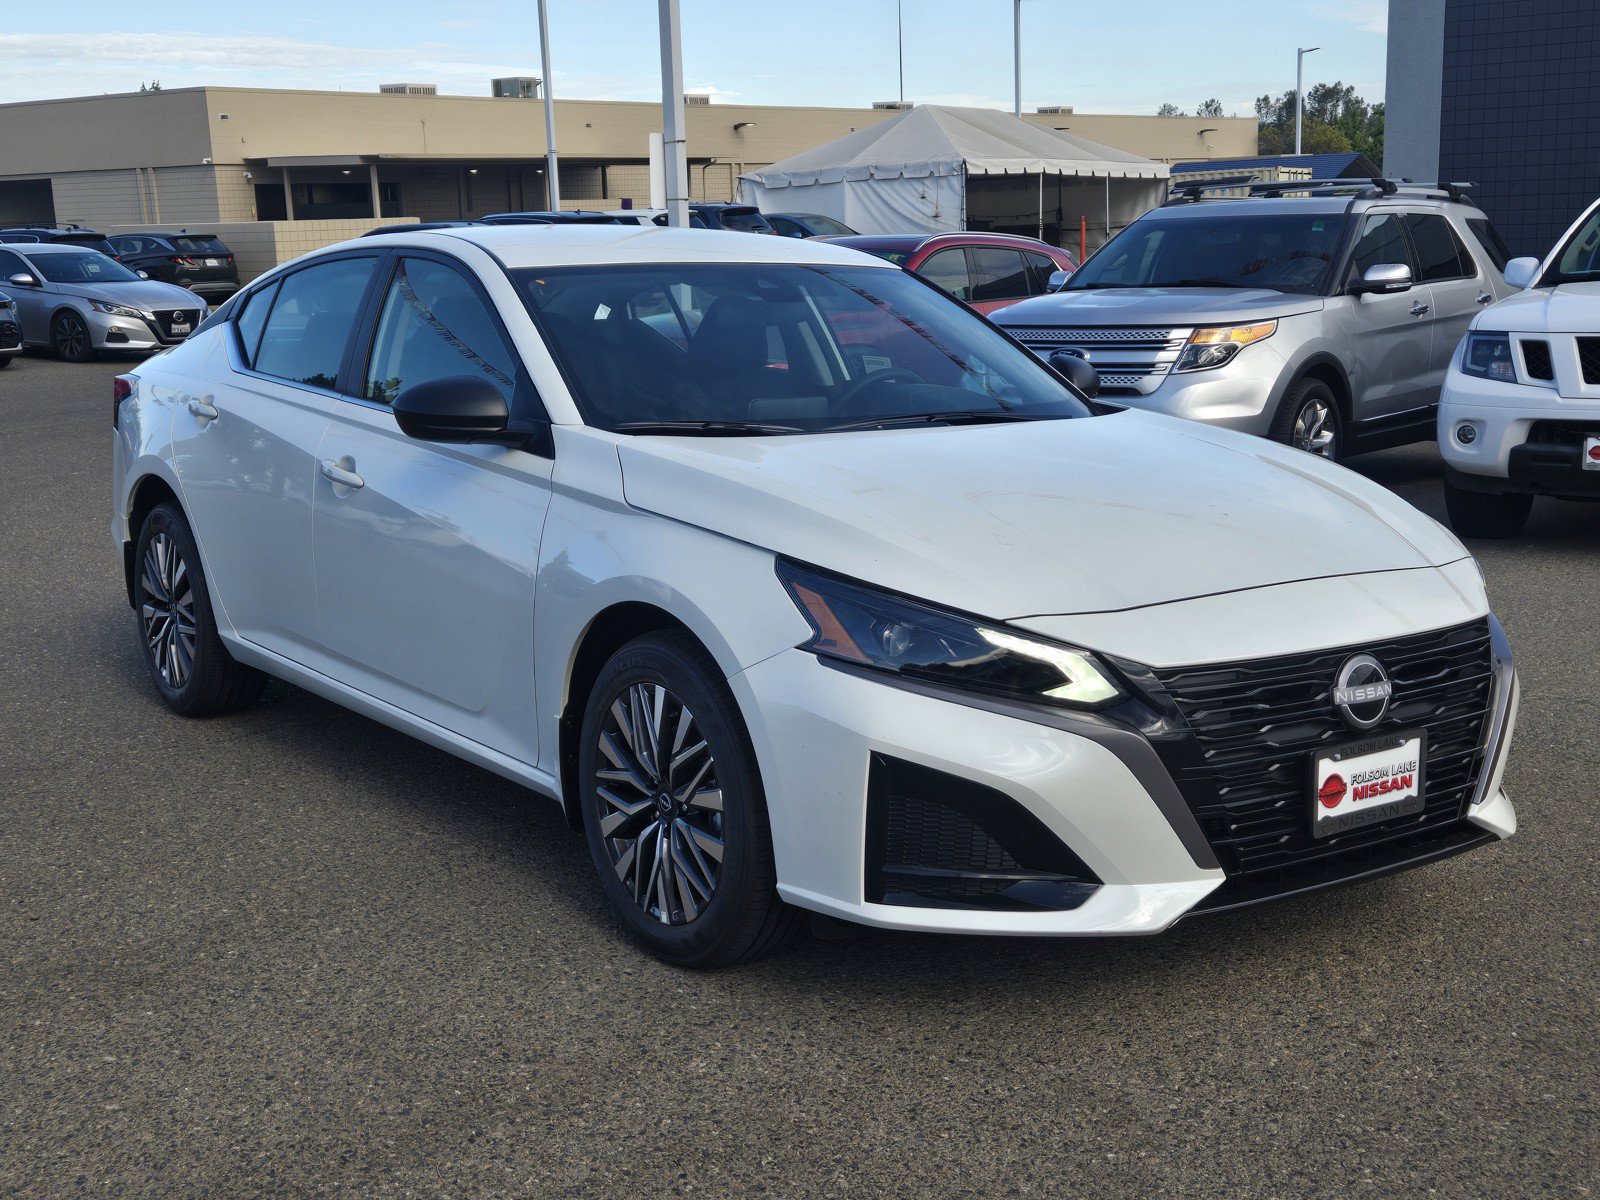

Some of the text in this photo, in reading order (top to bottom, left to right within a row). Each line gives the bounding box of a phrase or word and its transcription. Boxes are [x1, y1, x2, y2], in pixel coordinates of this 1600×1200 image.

[1336, 682, 1392, 703] NISSAN
[1340, 741, 1377, 758] FOLSOM
[1350, 760, 1417, 786] FOLSOM LAKE
[1352, 773, 1413, 802] NISSAN
[1339, 803, 1399, 829] NISSAN
